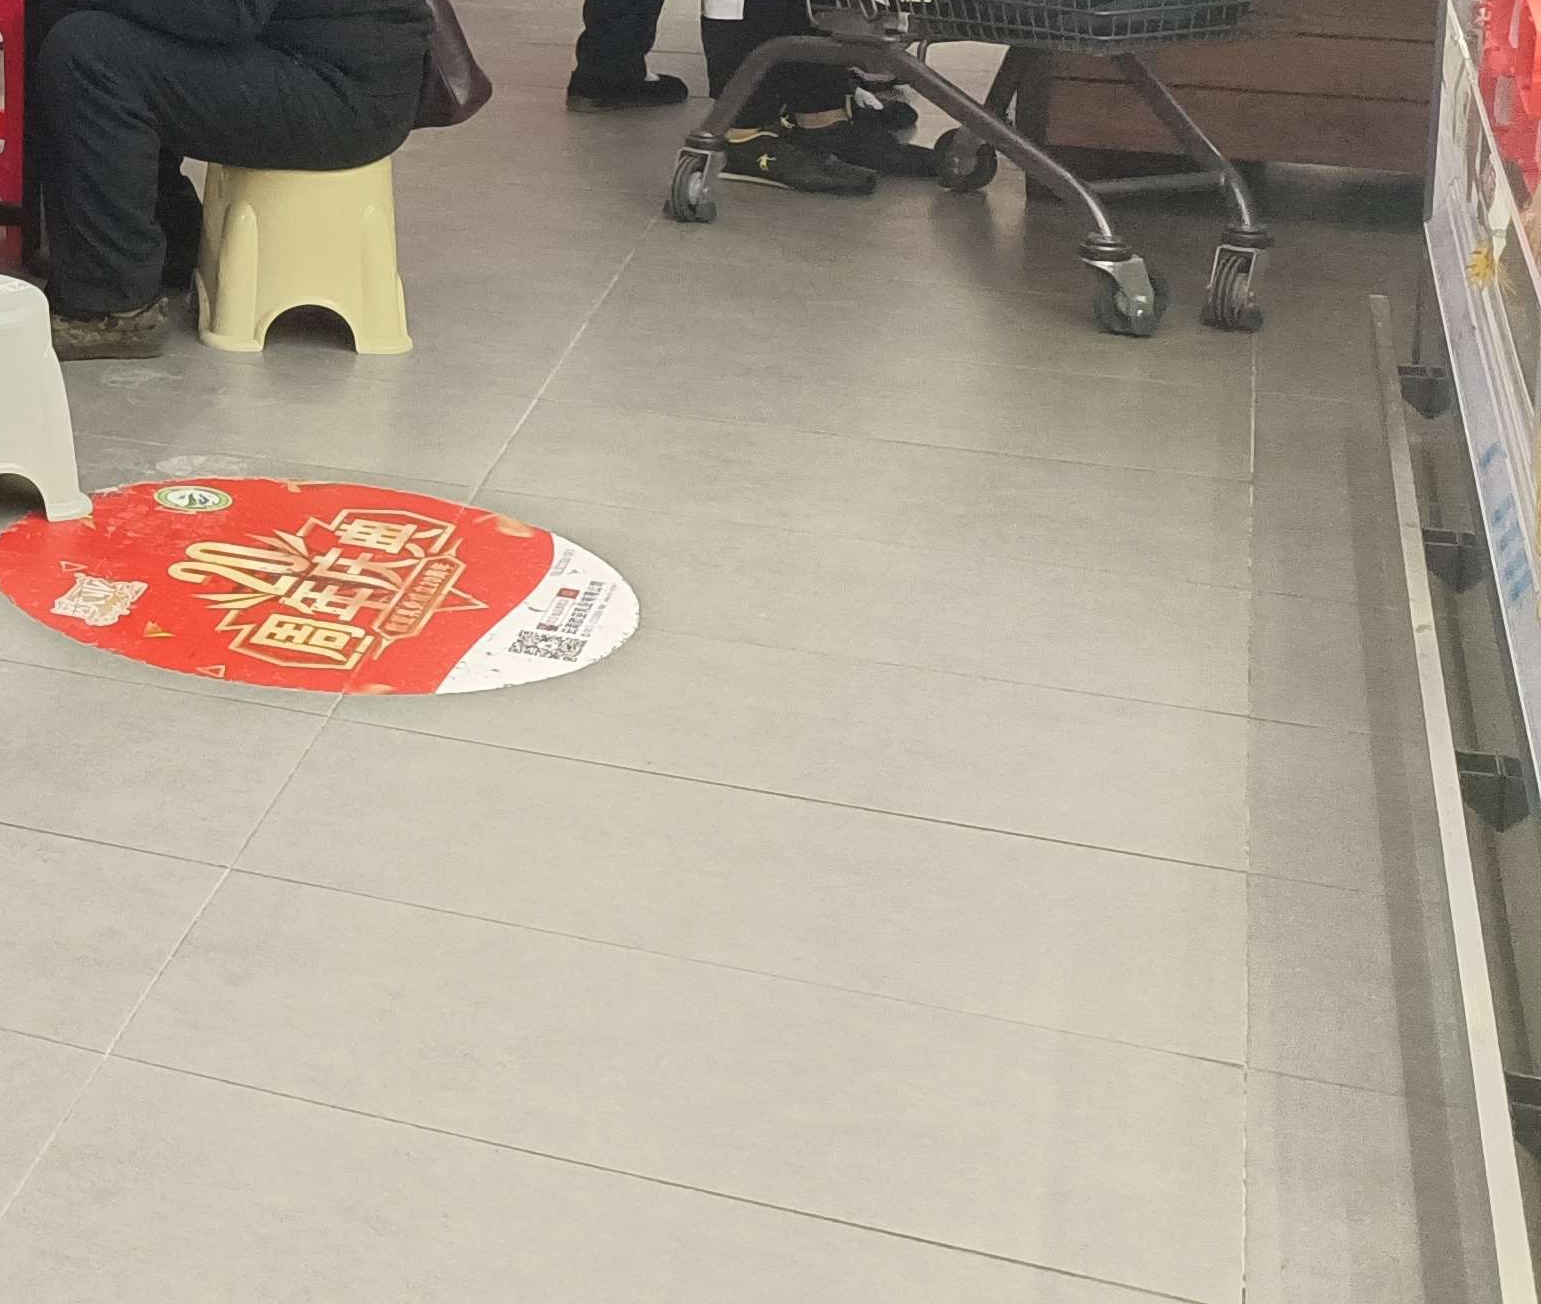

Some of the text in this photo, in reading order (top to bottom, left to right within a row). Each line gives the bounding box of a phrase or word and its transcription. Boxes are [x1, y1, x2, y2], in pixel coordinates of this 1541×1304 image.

[167, 542, 312, 609] 20
[250, 518, 439, 658] 周年庆典
